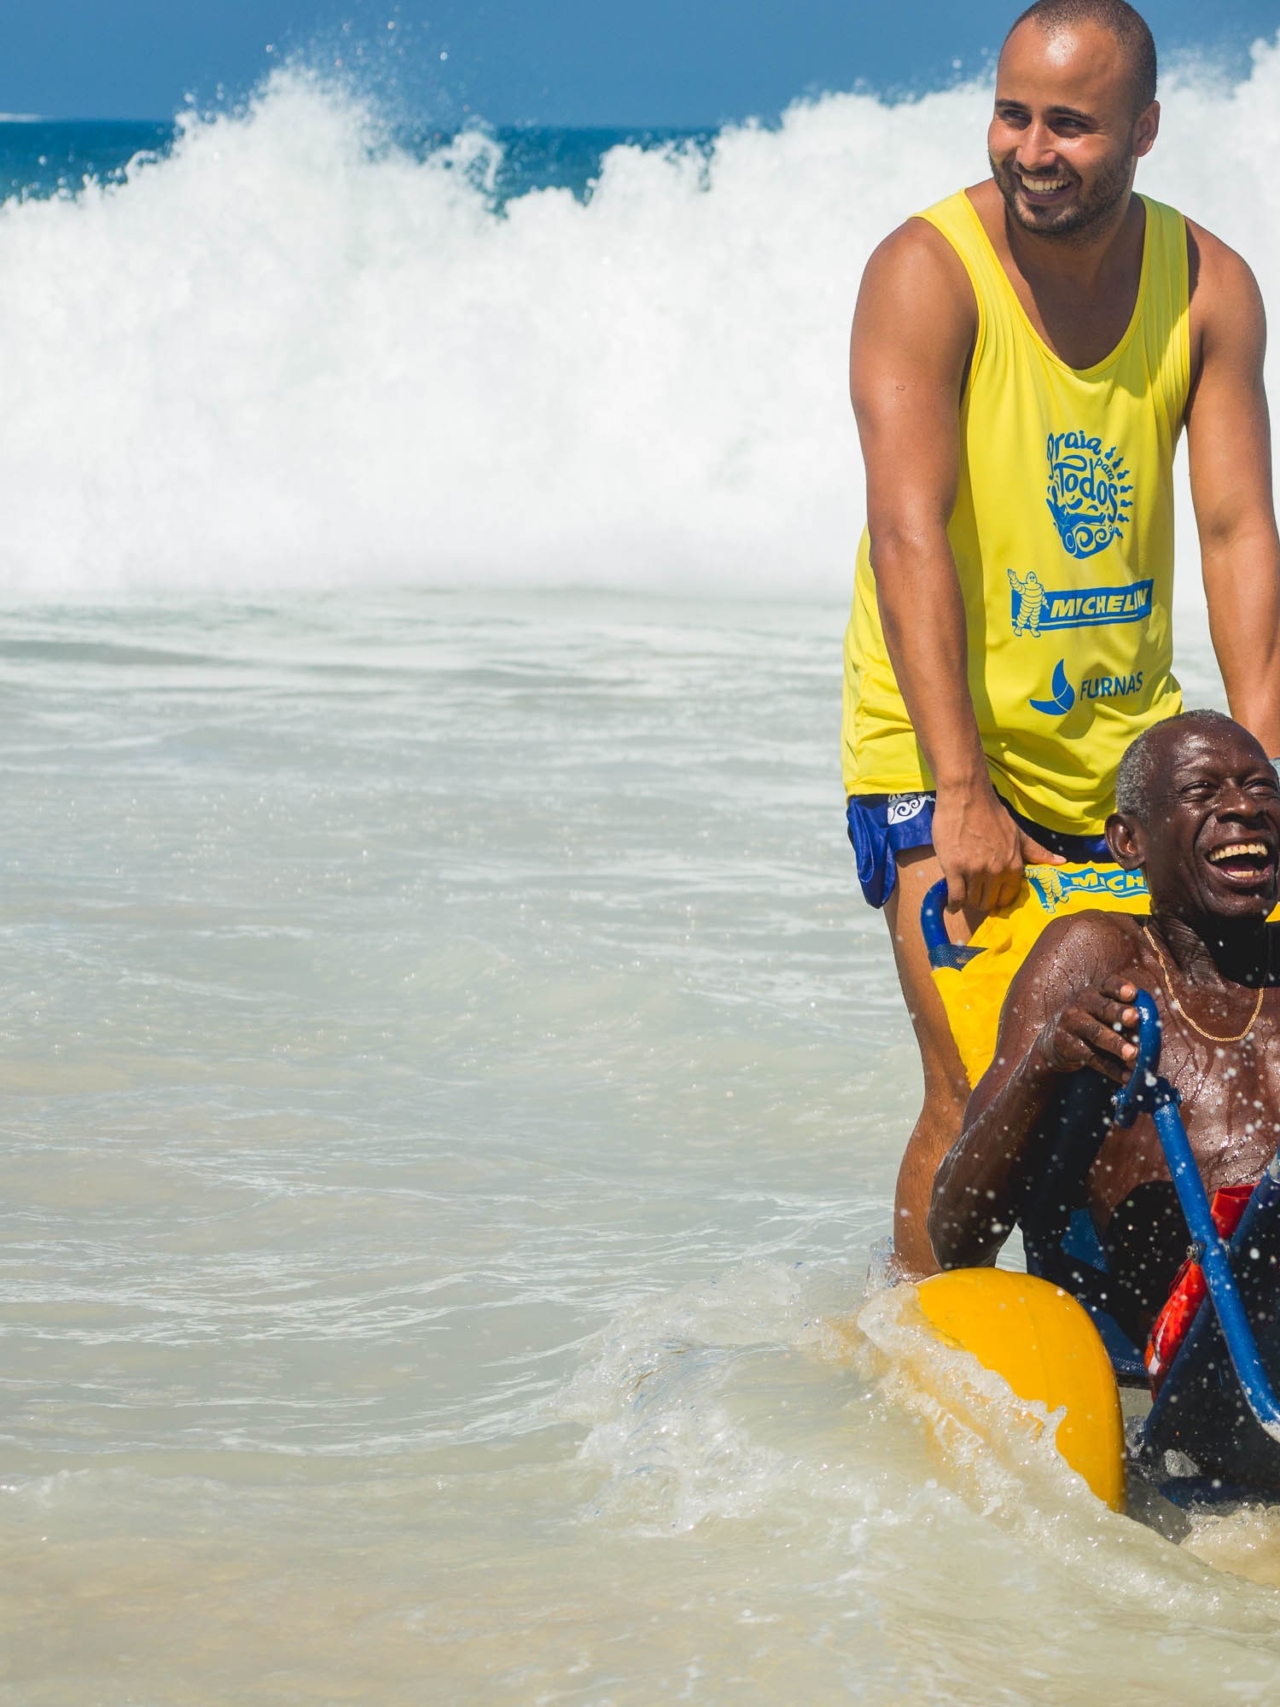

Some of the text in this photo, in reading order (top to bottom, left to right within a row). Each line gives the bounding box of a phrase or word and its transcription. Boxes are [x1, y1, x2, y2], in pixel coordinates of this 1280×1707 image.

[1094, 457, 1115, 482] para
[1053, 455, 1118, 524] Todos
[1049, 587, 1149, 619] MICHELIN
[1079, 671, 1143, 701] FURNAS
[1071, 872, 1146, 891] MICH
